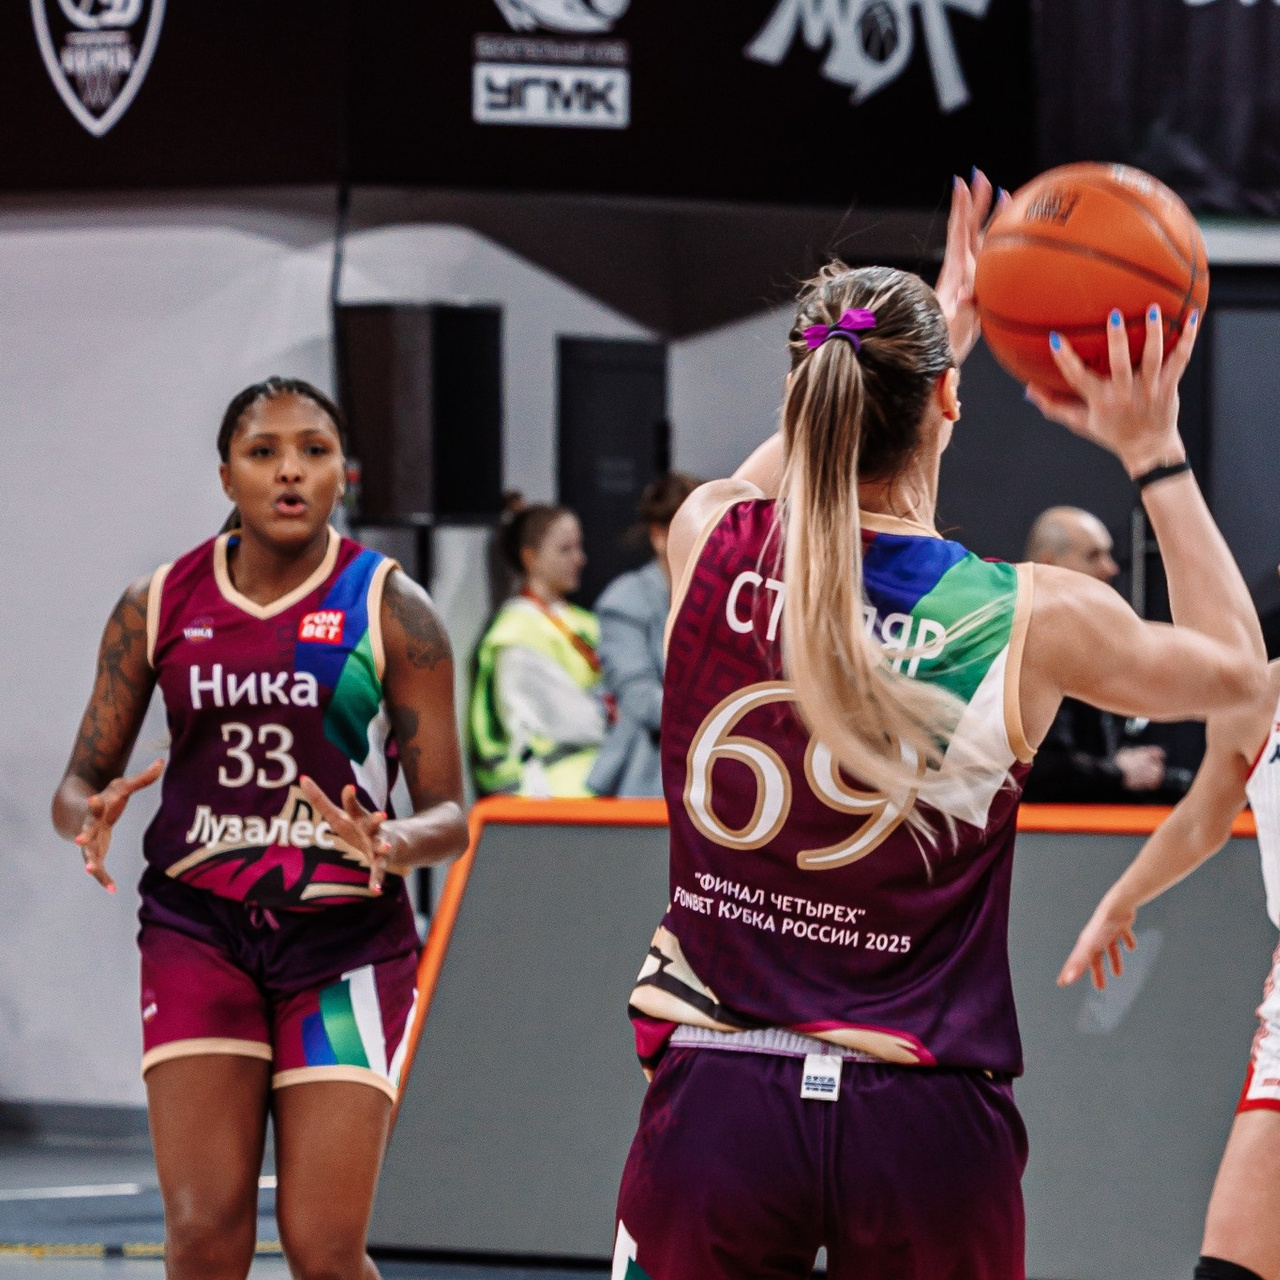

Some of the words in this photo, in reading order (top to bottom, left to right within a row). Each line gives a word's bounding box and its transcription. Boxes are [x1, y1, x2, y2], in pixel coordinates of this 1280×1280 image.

[485, 75, 617, 115] УГМК
[300, 623, 342, 640] BET
[302, 611, 343, 626] FON
[189, 663, 319, 710] Ника
[218, 722, 298, 788] 33
[683, 680, 927, 870] 69
[186, 804, 336, 849] Лузалес
[673, 886, 715, 916] FONBET
[717, 900, 777, 934] КУБКА
[781, 917, 860, 948] РОССИИ
[864, 932, 912, 954] 2025
[694, 871, 765, 906] "ФИНАЛ
[770, 892, 867, 924] ЧЕТЫРЕХ"
